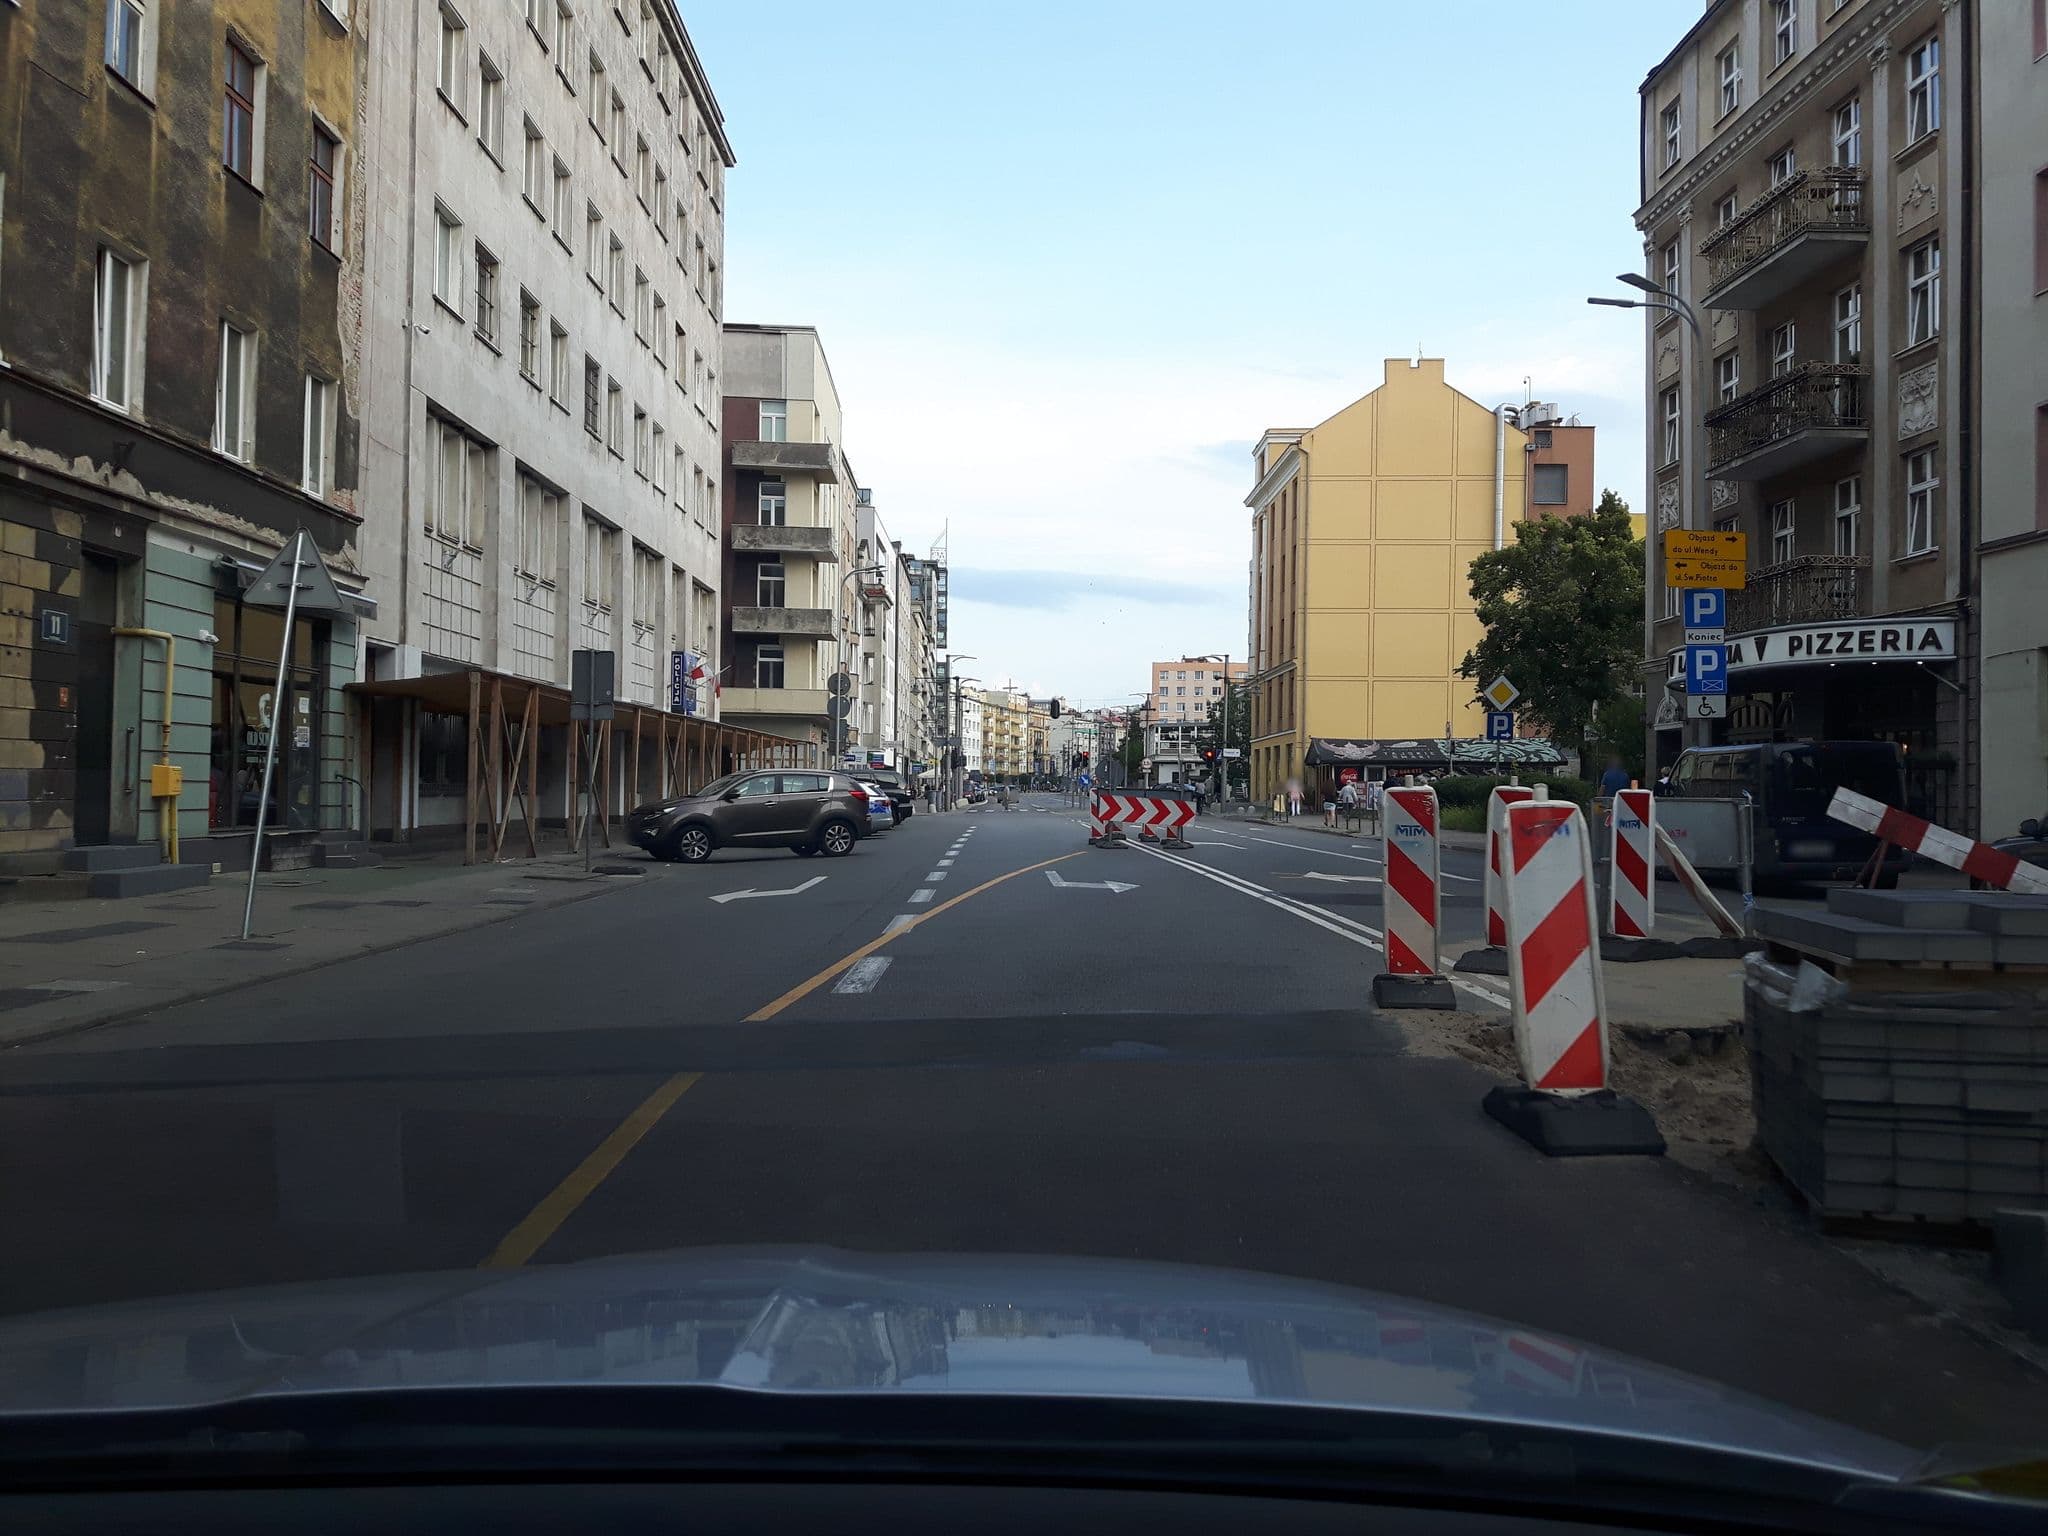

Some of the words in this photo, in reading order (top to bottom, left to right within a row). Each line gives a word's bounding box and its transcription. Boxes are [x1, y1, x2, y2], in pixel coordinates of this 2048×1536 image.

[1693, 593, 1716, 623] P
[51, 615, 61, 635] 11
[1688, 632, 1721, 641] Koniec
[1788, 627, 1943, 657] PIZZERIA
[1696, 650, 1718, 680] P
[673, 657, 681, 703] POLICJA
[1493, 715, 1509, 736] P
[1395, 823, 1426, 837] MTM
